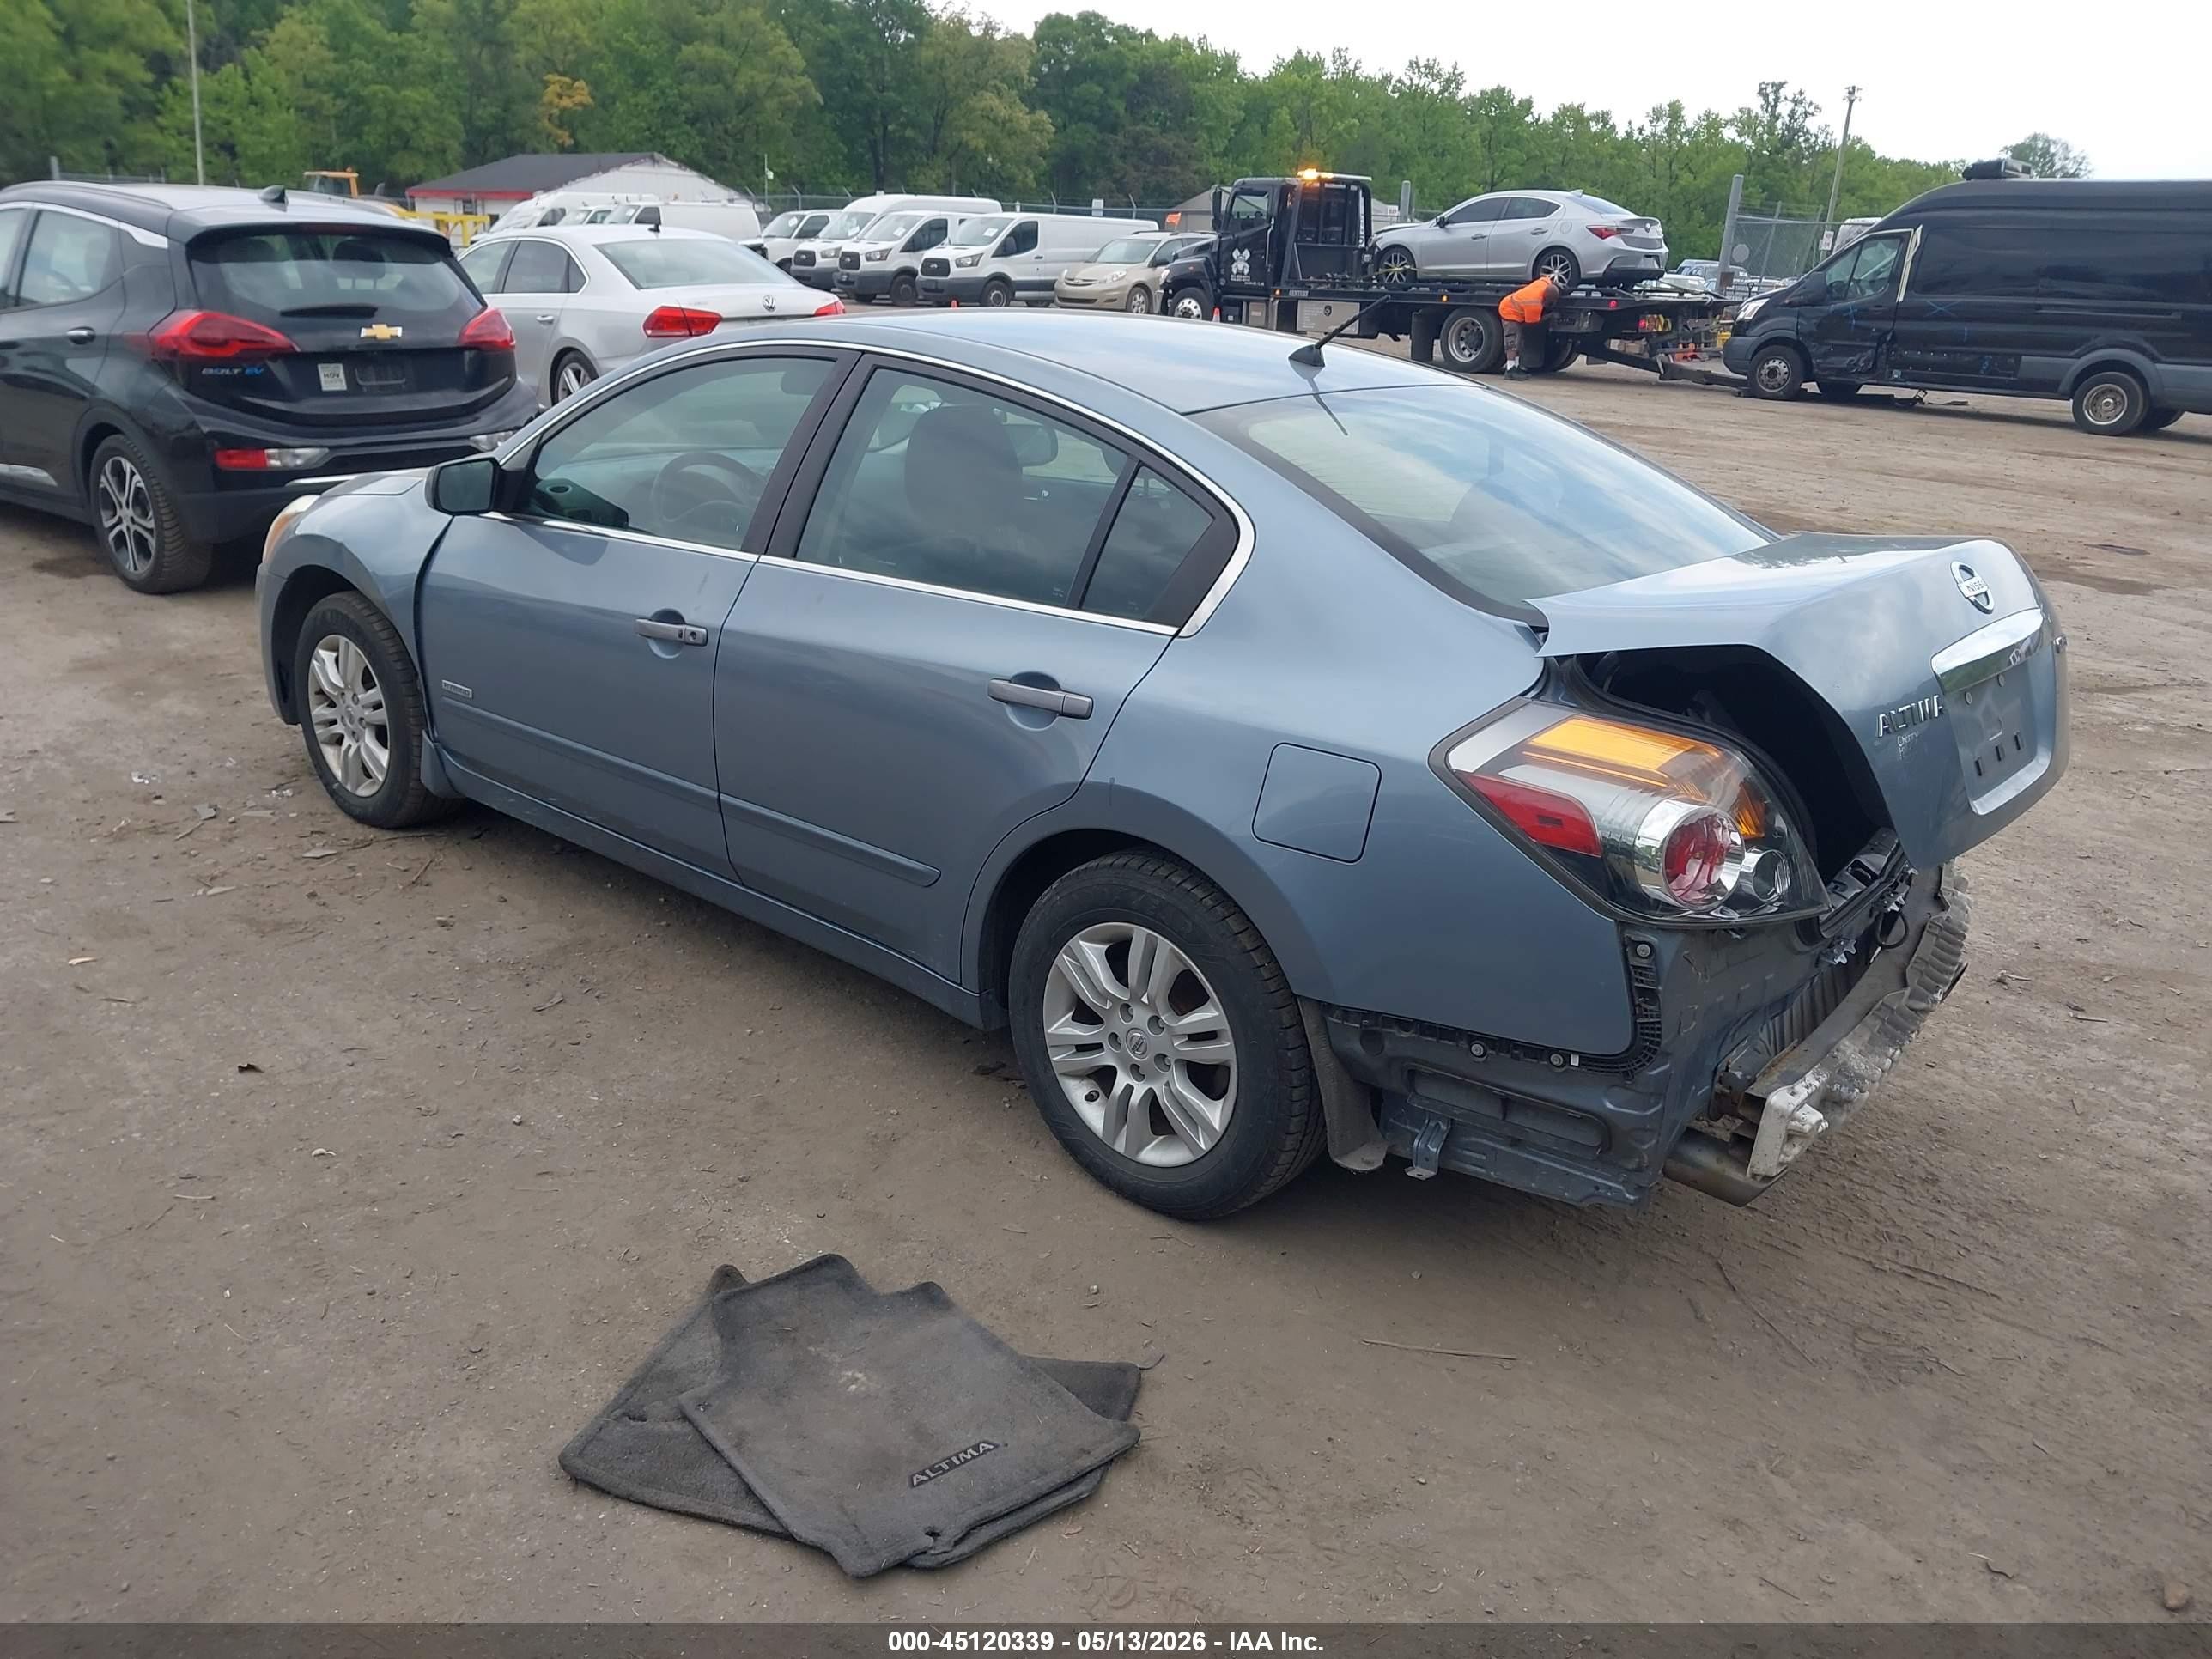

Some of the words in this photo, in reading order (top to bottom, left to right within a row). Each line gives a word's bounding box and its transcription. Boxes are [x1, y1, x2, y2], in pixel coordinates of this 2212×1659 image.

[201, 367, 242, 375] BOLT
[245, 367, 264, 375] EV
[1875, 695, 1943, 738] ALTIMA
[911, 1443, 995, 1487] ALTIMA
